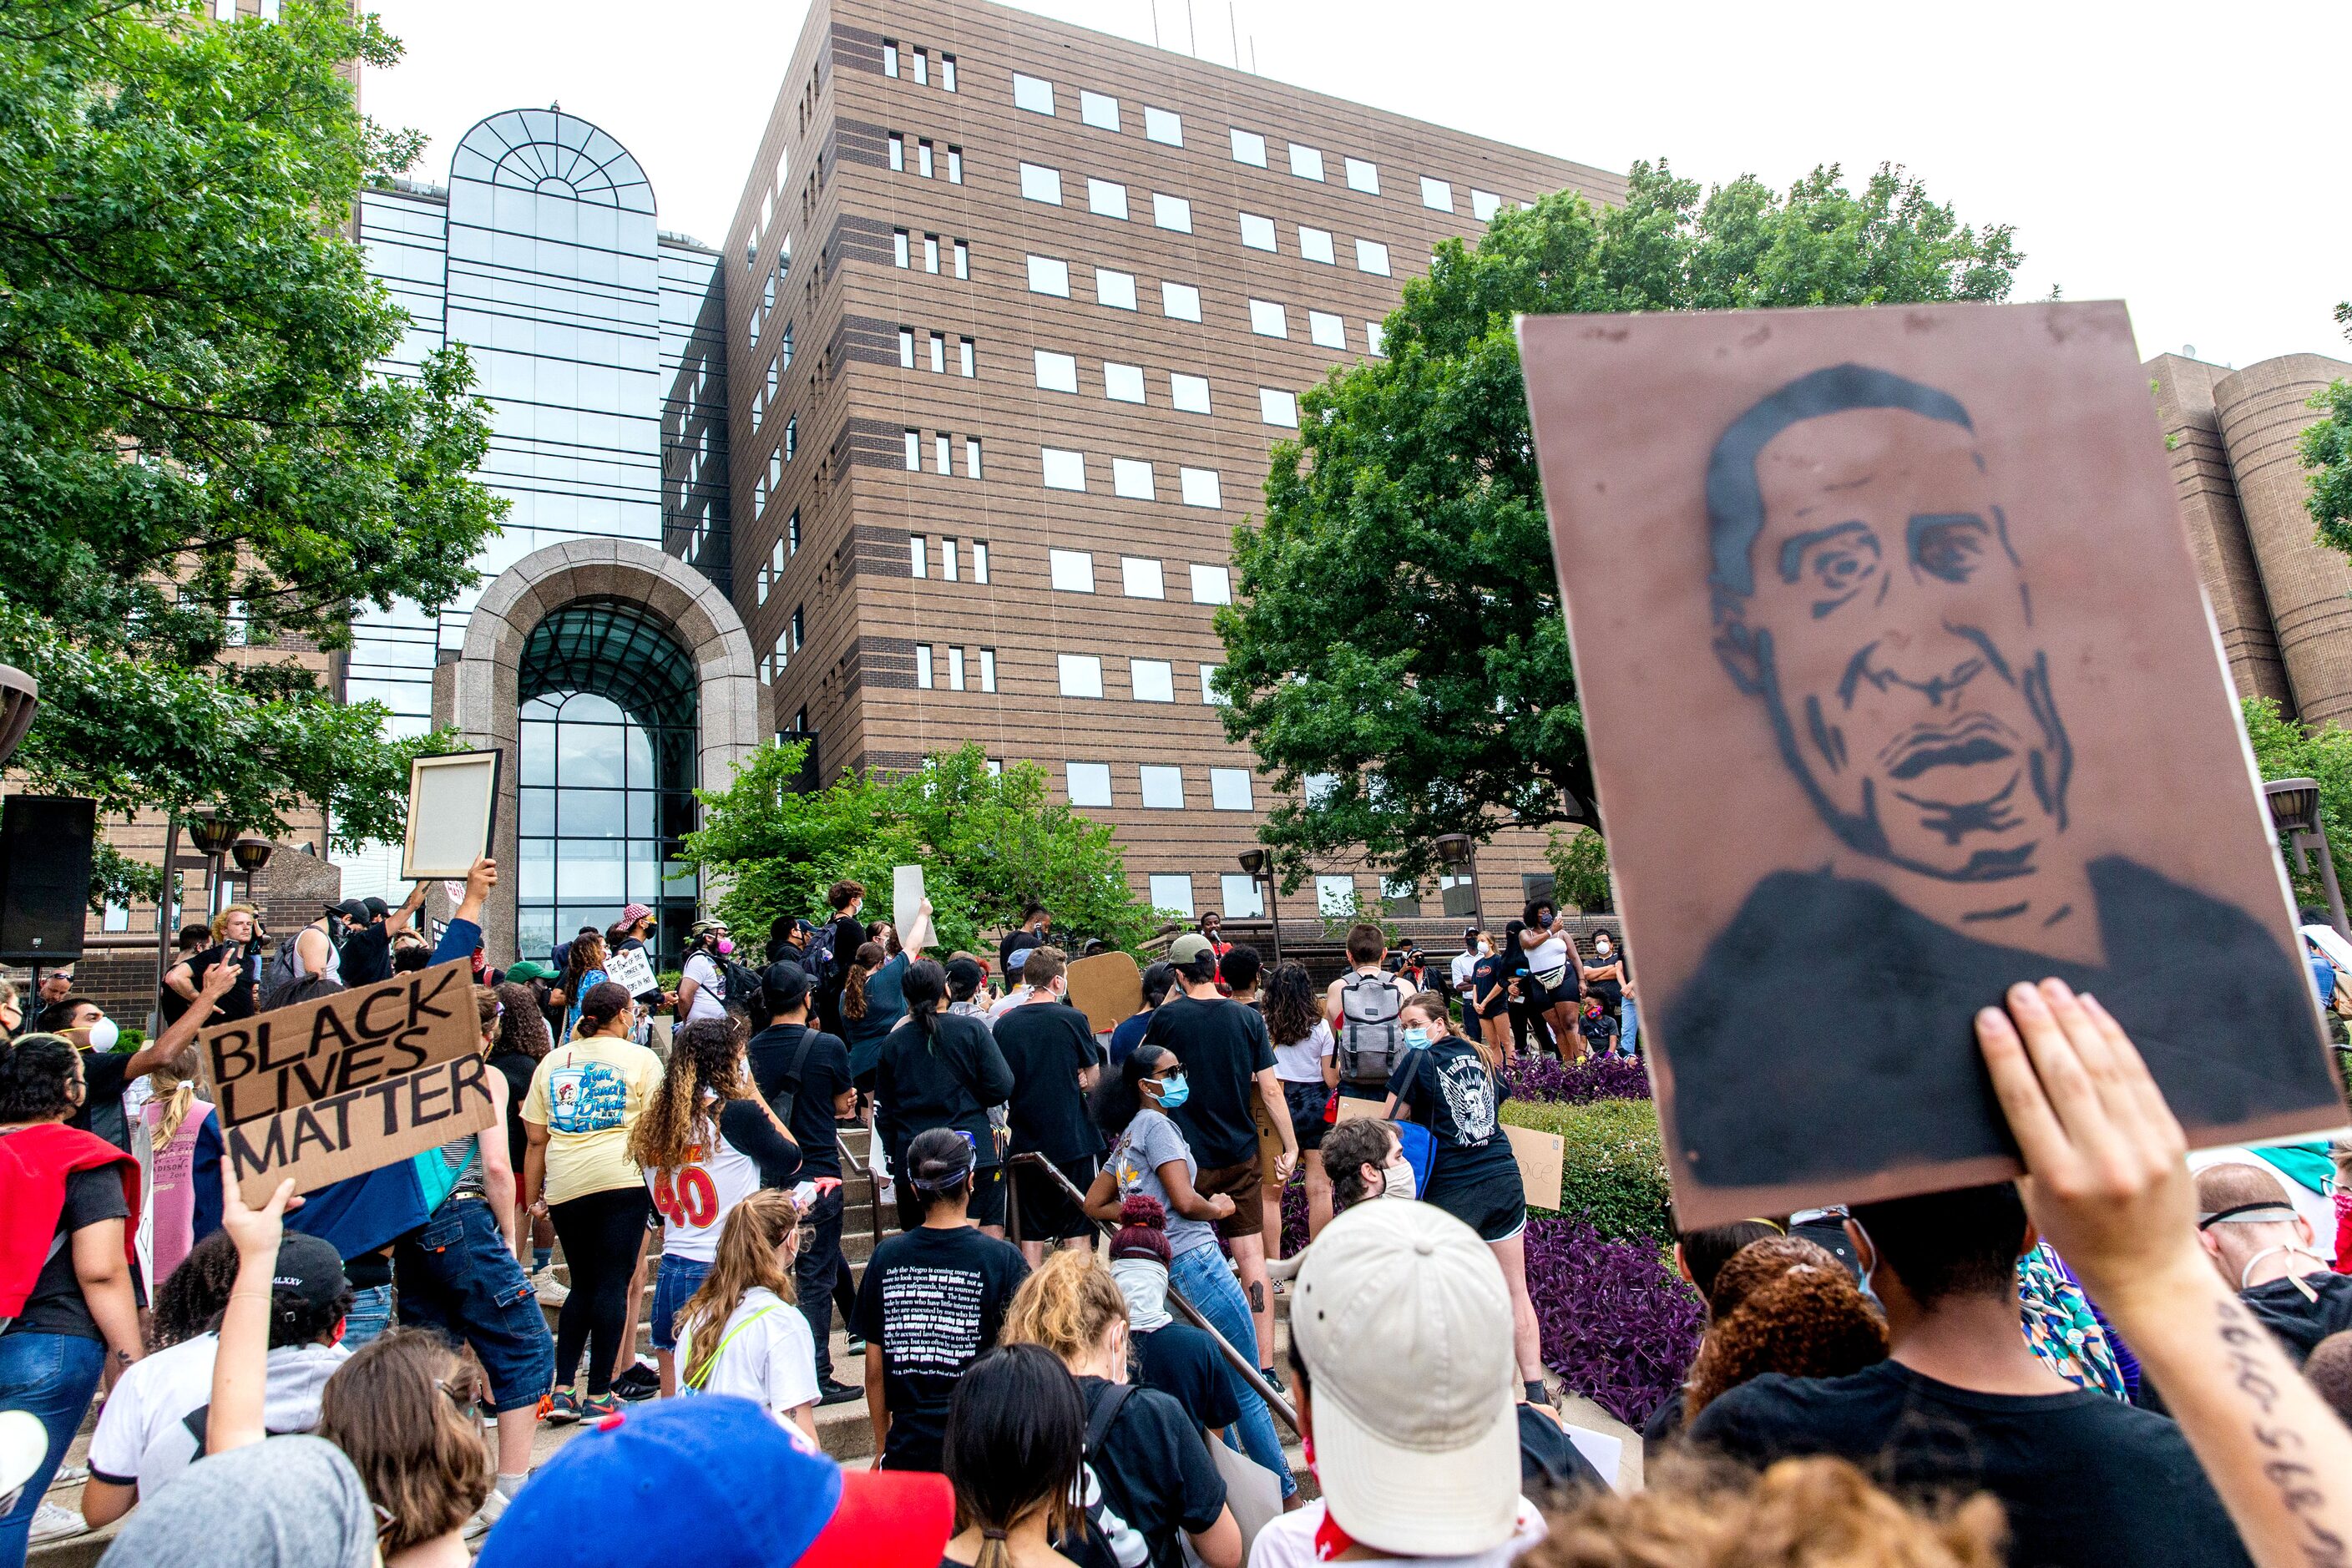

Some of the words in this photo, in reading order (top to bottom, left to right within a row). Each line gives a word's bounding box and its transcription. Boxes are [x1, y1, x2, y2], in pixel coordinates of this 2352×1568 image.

[210, 969, 458, 1085] BLACK
[221, 1026, 429, 1128] LIVES
[579, 1062, 615, 1088] Sun,
[579, 1093, 626, 1116] Drink
[228, 1052, 493, 1182] MATTER
[576, 1113, 623, 1133] Hand
[654, 1166, 719, 1228] 40
[885, 1339, 890, 1348] by
[923, 1330, 950, 1339] lawbreaker
[954, 1349, 975, 1358] Negroes
